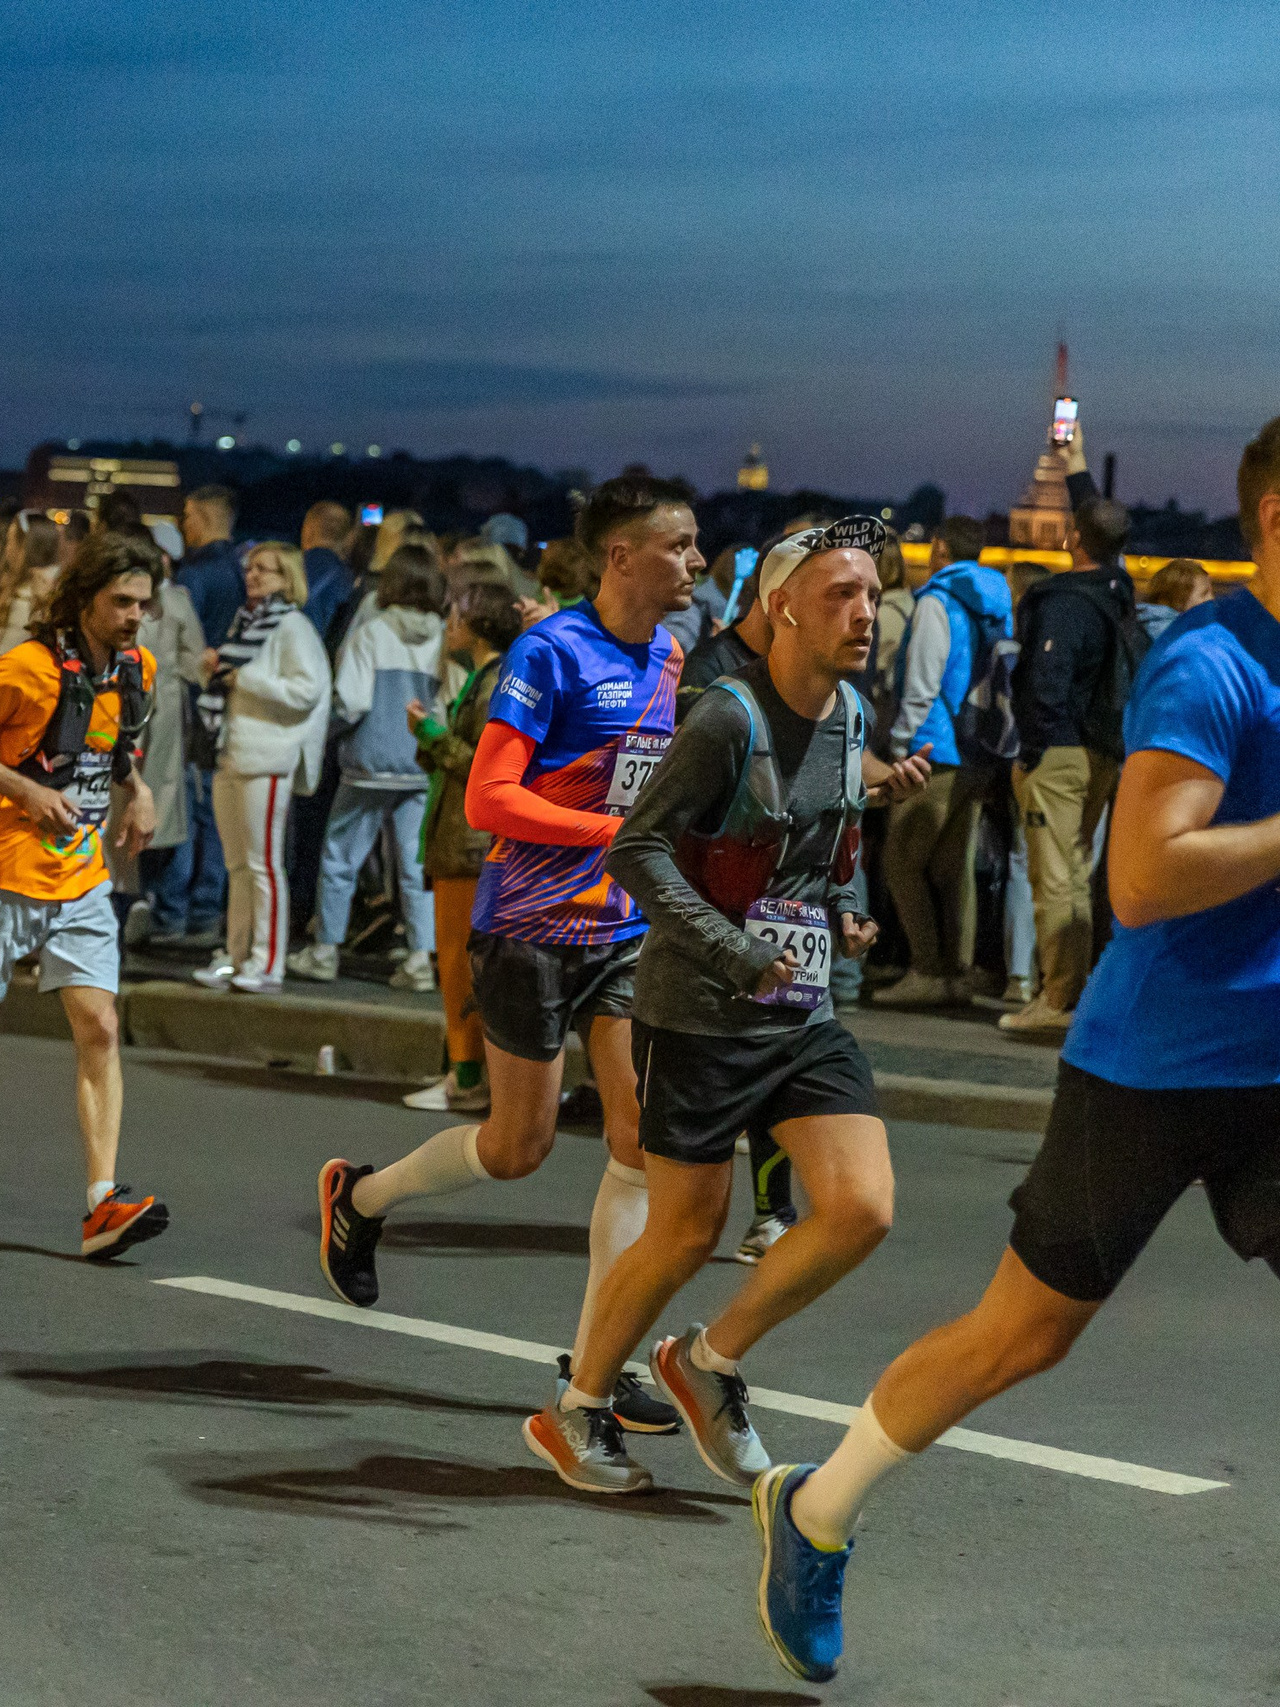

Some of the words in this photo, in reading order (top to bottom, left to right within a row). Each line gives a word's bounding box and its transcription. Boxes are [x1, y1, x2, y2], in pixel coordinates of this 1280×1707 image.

[834, 521, 870, 537] WILD
[832, 533, 872, 548] TRAIL
[510, 677, 543, 701] ГАЗПРОМ
[596, 680, 633, 691] КОМАНДА
[597, 690, 633, 700] ГАЗПРОМ
[598, 699, 627, 709] НЕФТИ
[625, 735, 653, 750] БЕЛЫЕ
[621, 760, 660, 791] 37
[760, 899, 798, 918] БЕЛЫЕ
[558, 1420, 591, 1463] HOKA
